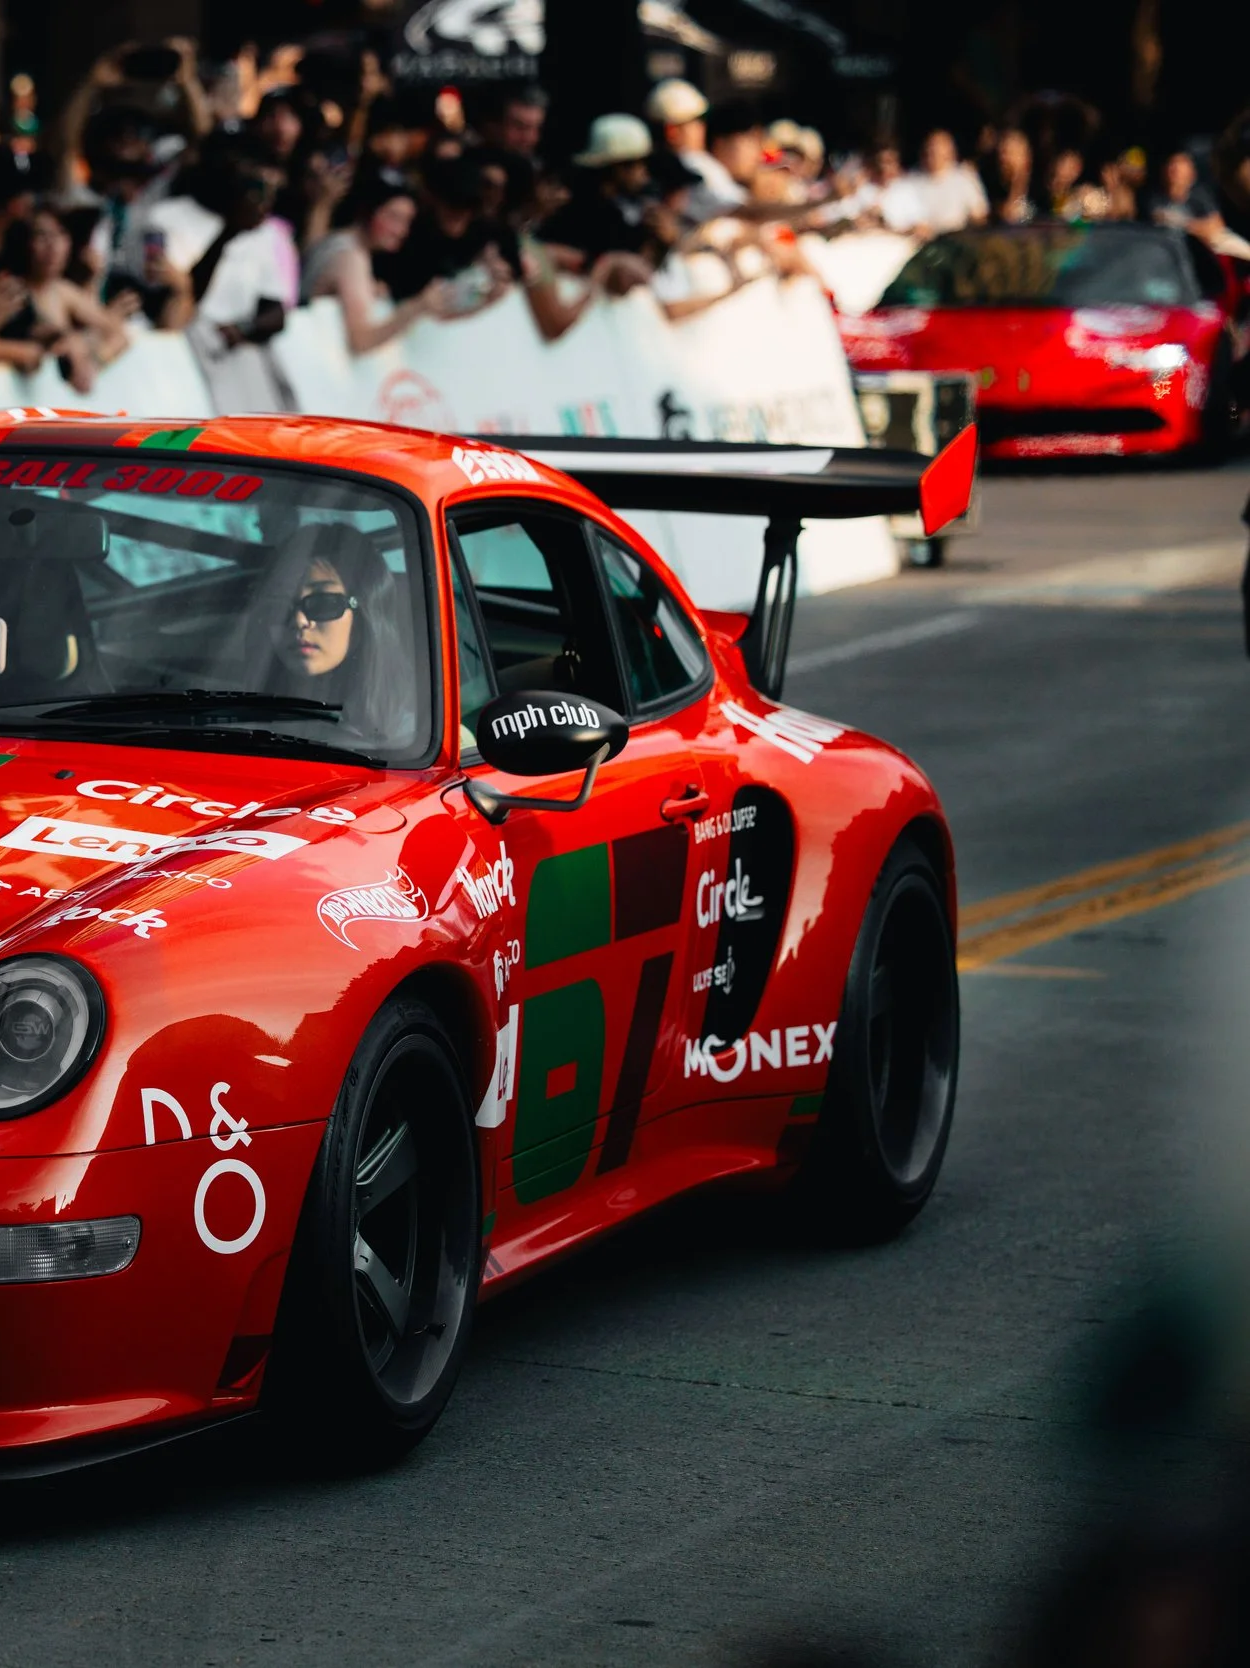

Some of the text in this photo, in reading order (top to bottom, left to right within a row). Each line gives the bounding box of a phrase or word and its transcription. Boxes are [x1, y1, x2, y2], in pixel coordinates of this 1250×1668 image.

[102, 465, 264, 501] 3000
[491, 701, 600, 741] mph club
[684, 1021, 838, 1083] MONEX
